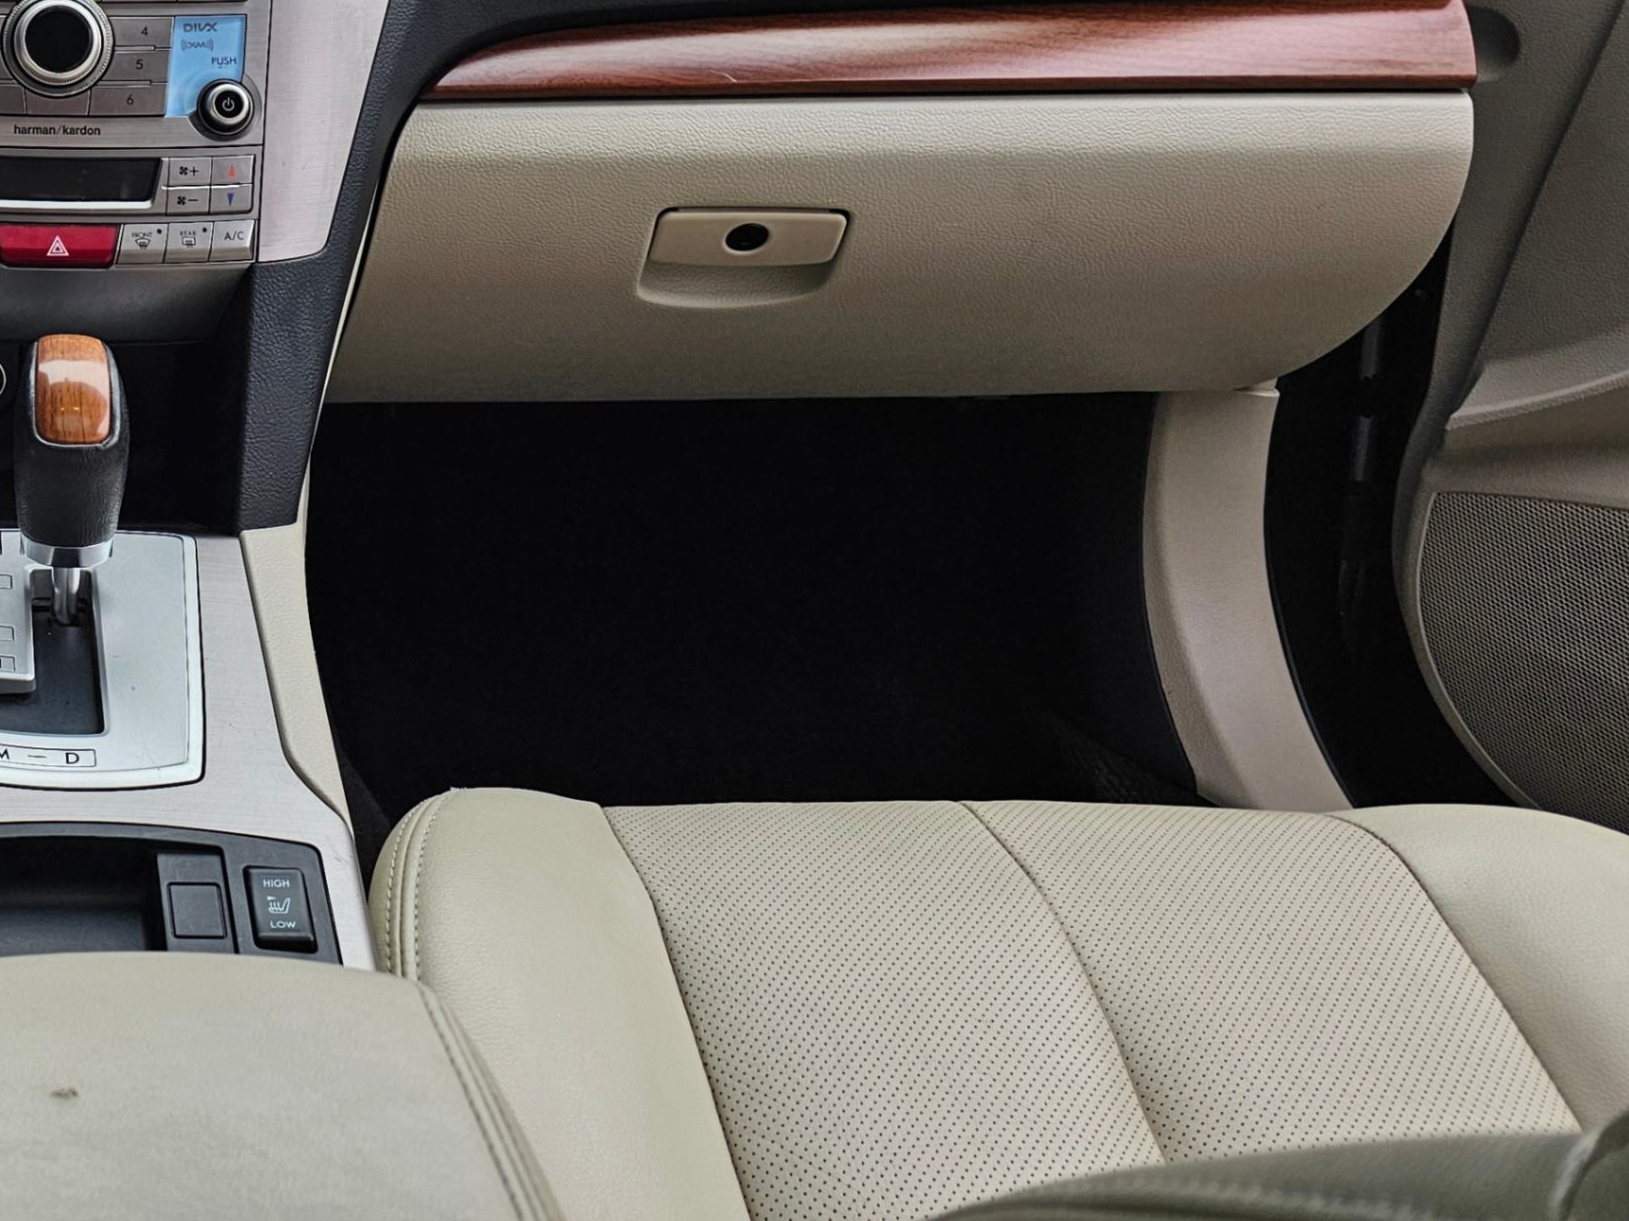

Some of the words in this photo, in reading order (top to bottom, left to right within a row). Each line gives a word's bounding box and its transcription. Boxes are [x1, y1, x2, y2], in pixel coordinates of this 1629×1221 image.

[140, 26, 149, 37] 4
[135, 59, 144, 70] 5
[211, 56, 237, 66] PUSH
[126, 94, 135, 106] 6
[13, 124, 101, 136] harman/kardon
[223, 231, 245, 242] A/C
[65, 752, 80, 764] D
[262, 878, 291, 889] HIGH
[269, 919, 296, 930] LOW
